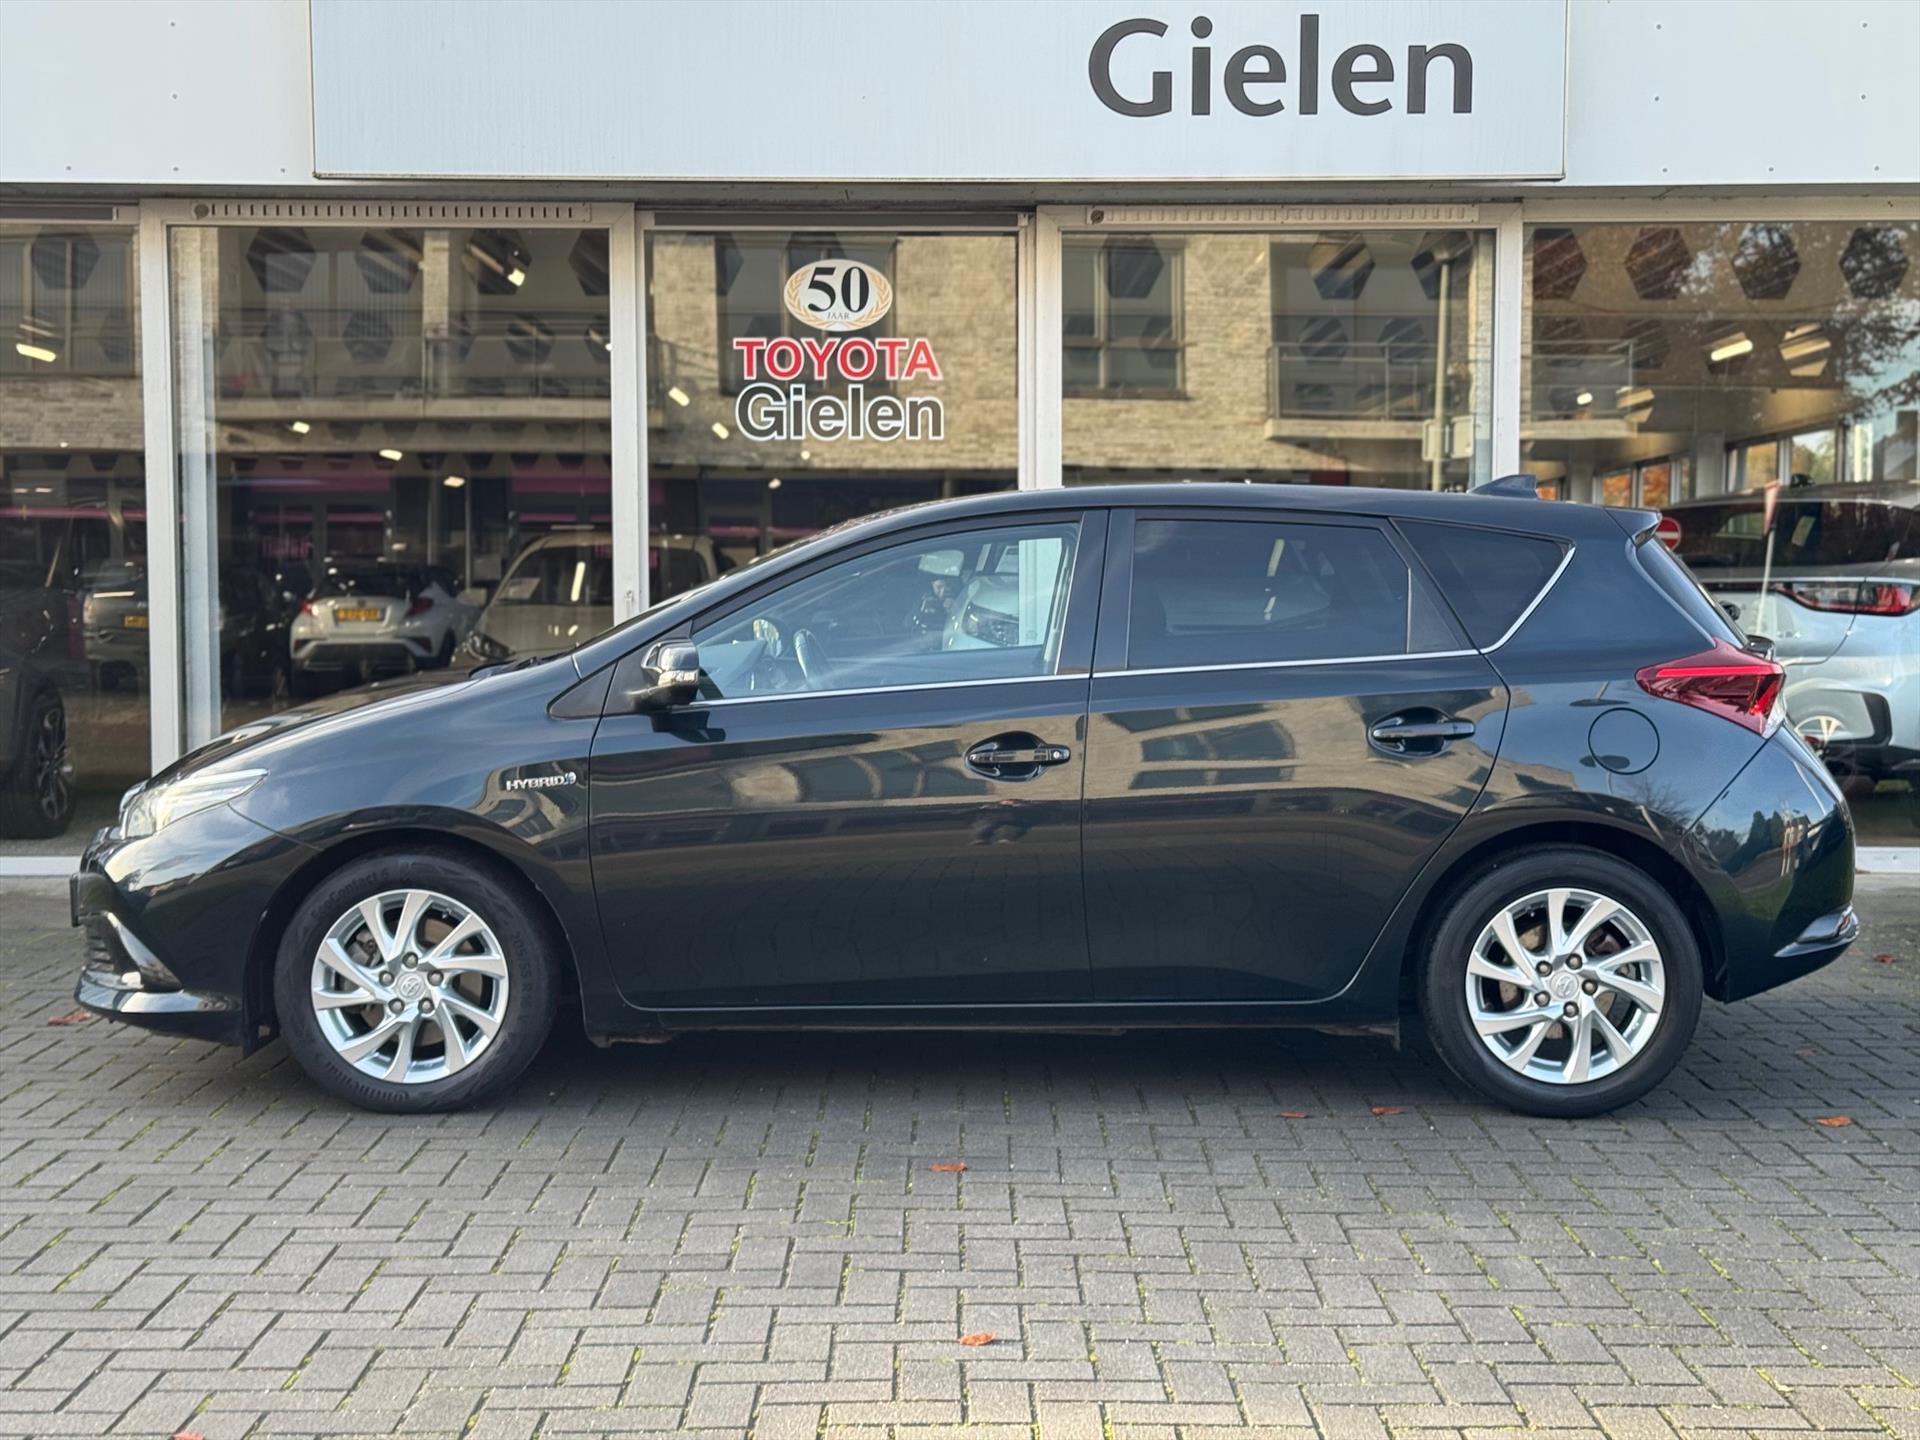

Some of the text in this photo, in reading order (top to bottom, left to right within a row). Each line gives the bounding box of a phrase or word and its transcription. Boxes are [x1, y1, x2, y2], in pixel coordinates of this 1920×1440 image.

[1088, 14, 1473, 117] Gielen
[807, 266, 869, 312] 50
[827, 311, 850, 320] JAAR
[733, 337, 943, 380] TOYOTA
[736, 383, 944, 441] Gielen
[506, 775, 565, 791] HYBRID
